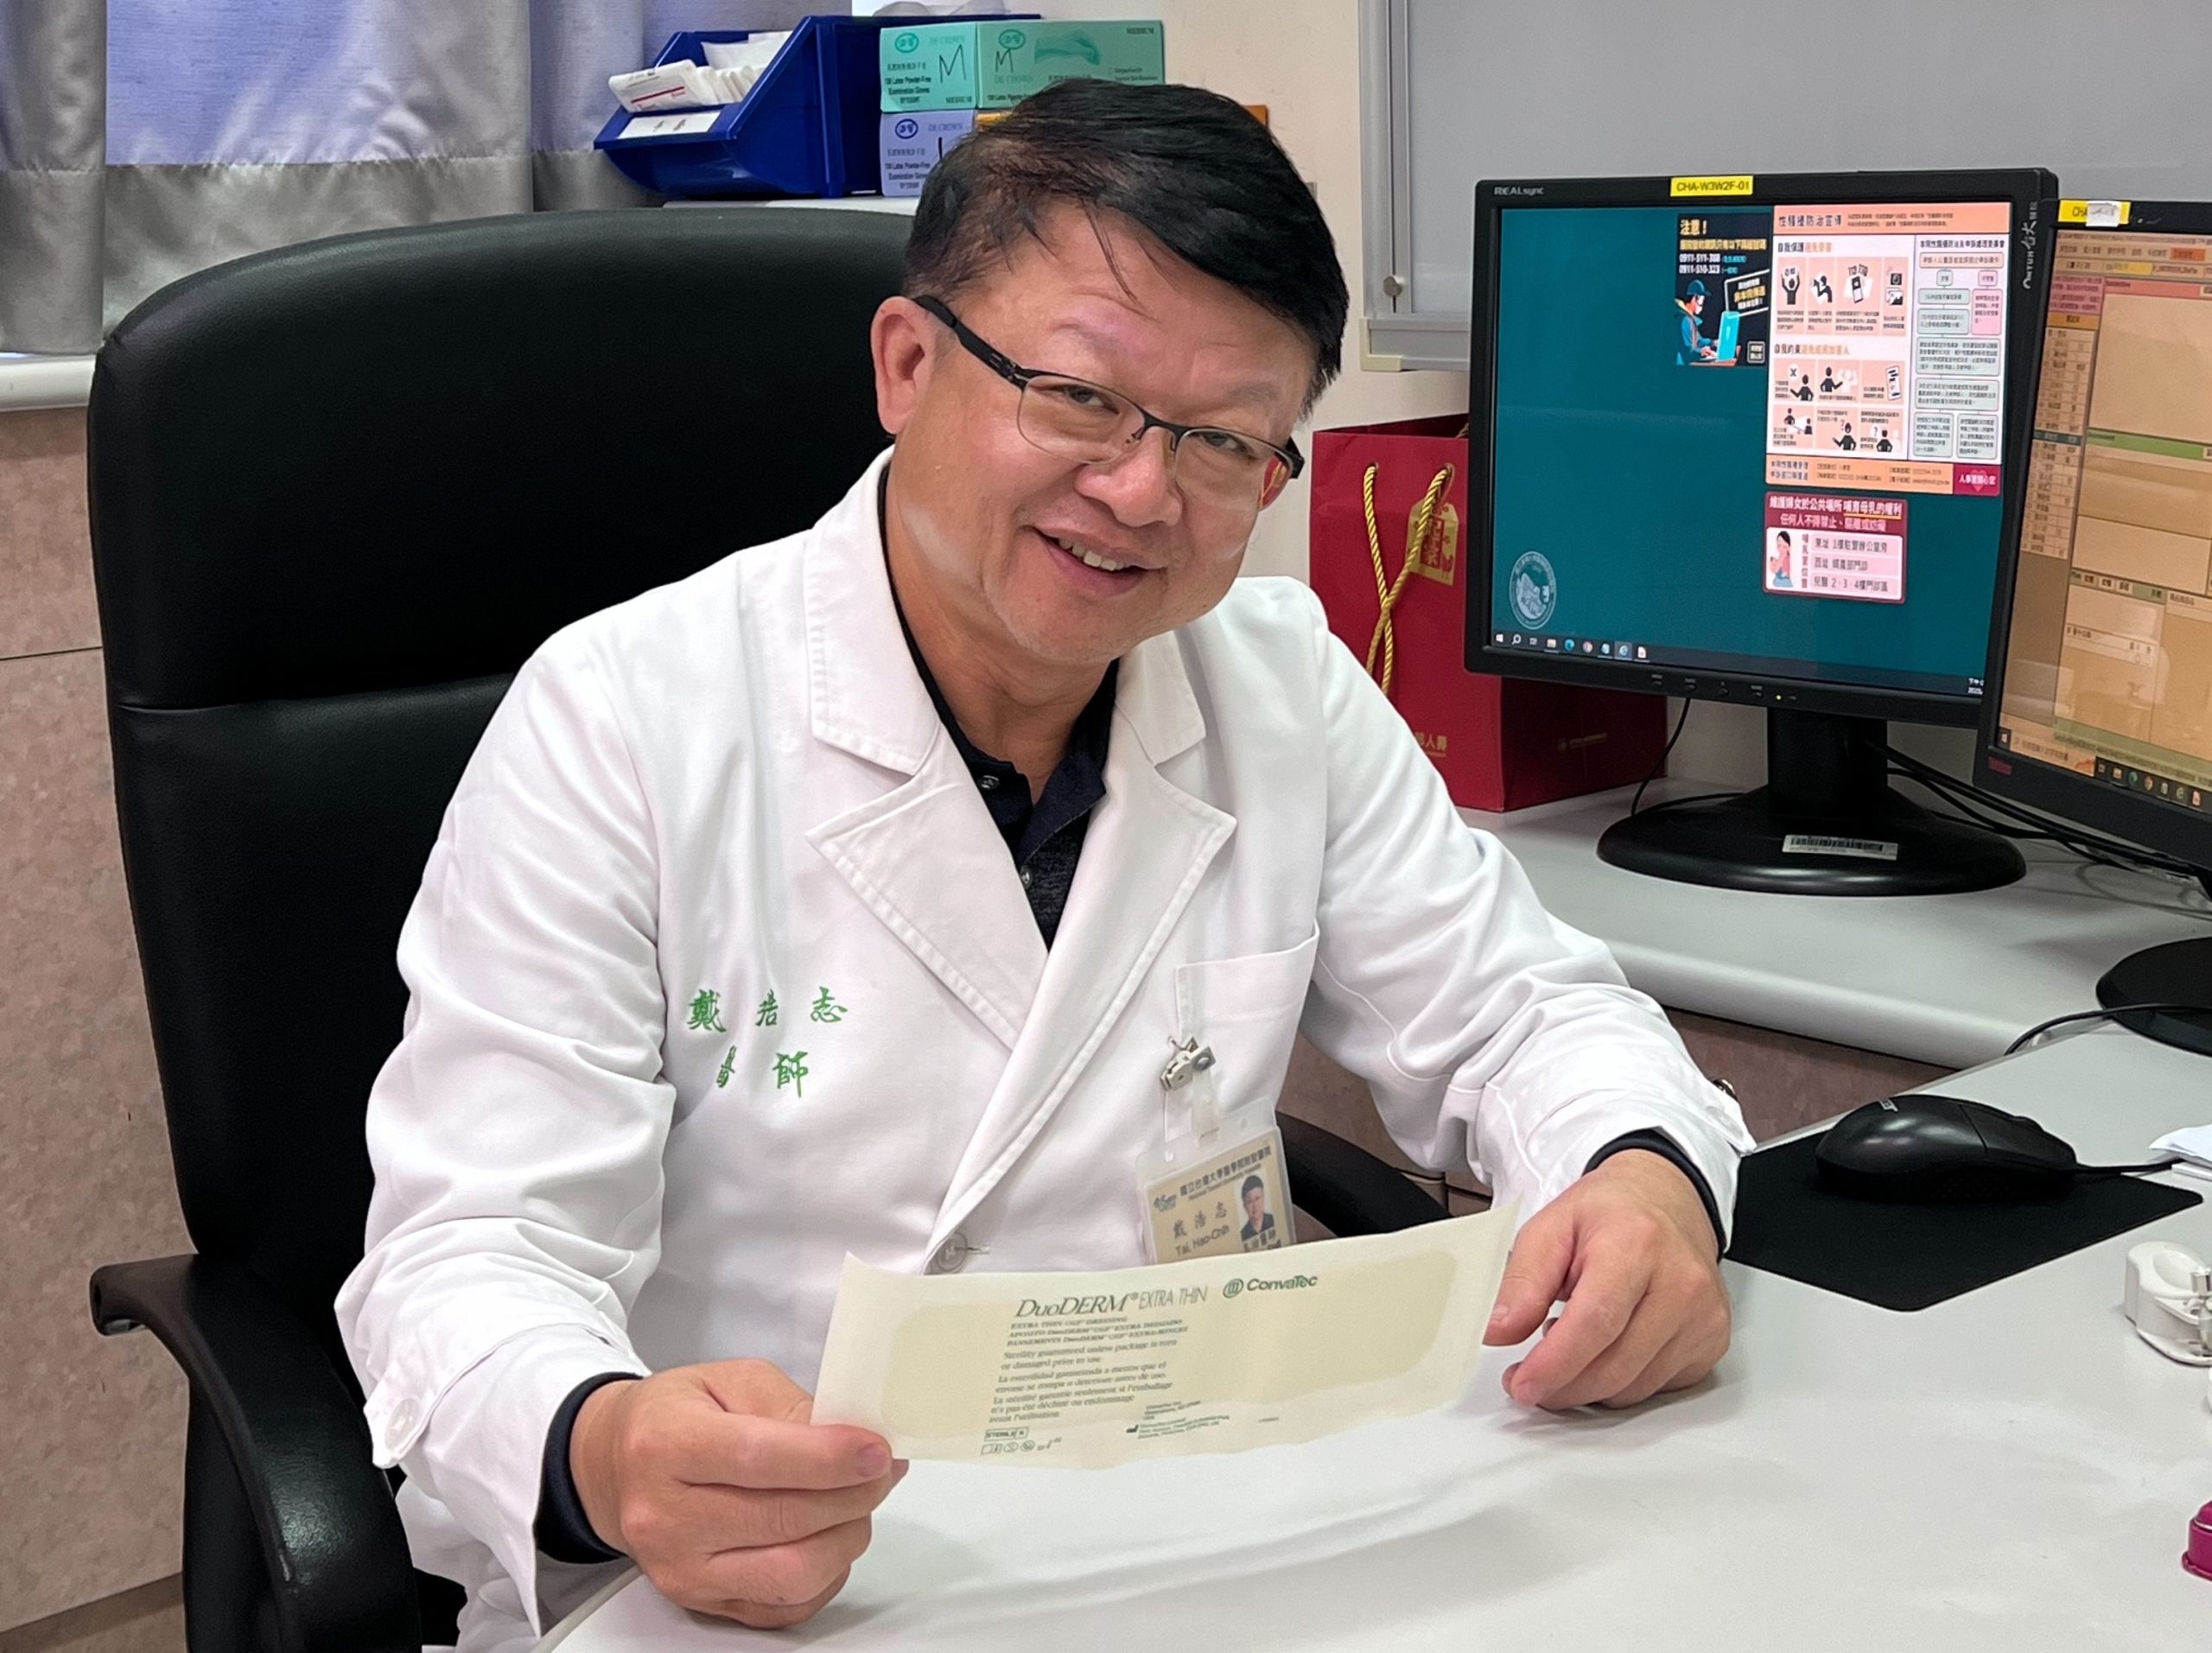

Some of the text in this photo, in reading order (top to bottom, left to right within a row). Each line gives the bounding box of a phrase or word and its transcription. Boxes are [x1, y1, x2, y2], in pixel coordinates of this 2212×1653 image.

[938, 44, 966, 84] M
[995, 48, 1014, 73] M
[1494, 185, 1543, 195] REALsync
[1676, 181, 1750, 193] CHA-W3W2F-01
[1247, 1275, 1319, 1292] ConvaTec
[1138, 1289, 1174, 1310] EXTRA
[1178, 1285, 1209, 1306] THIN
